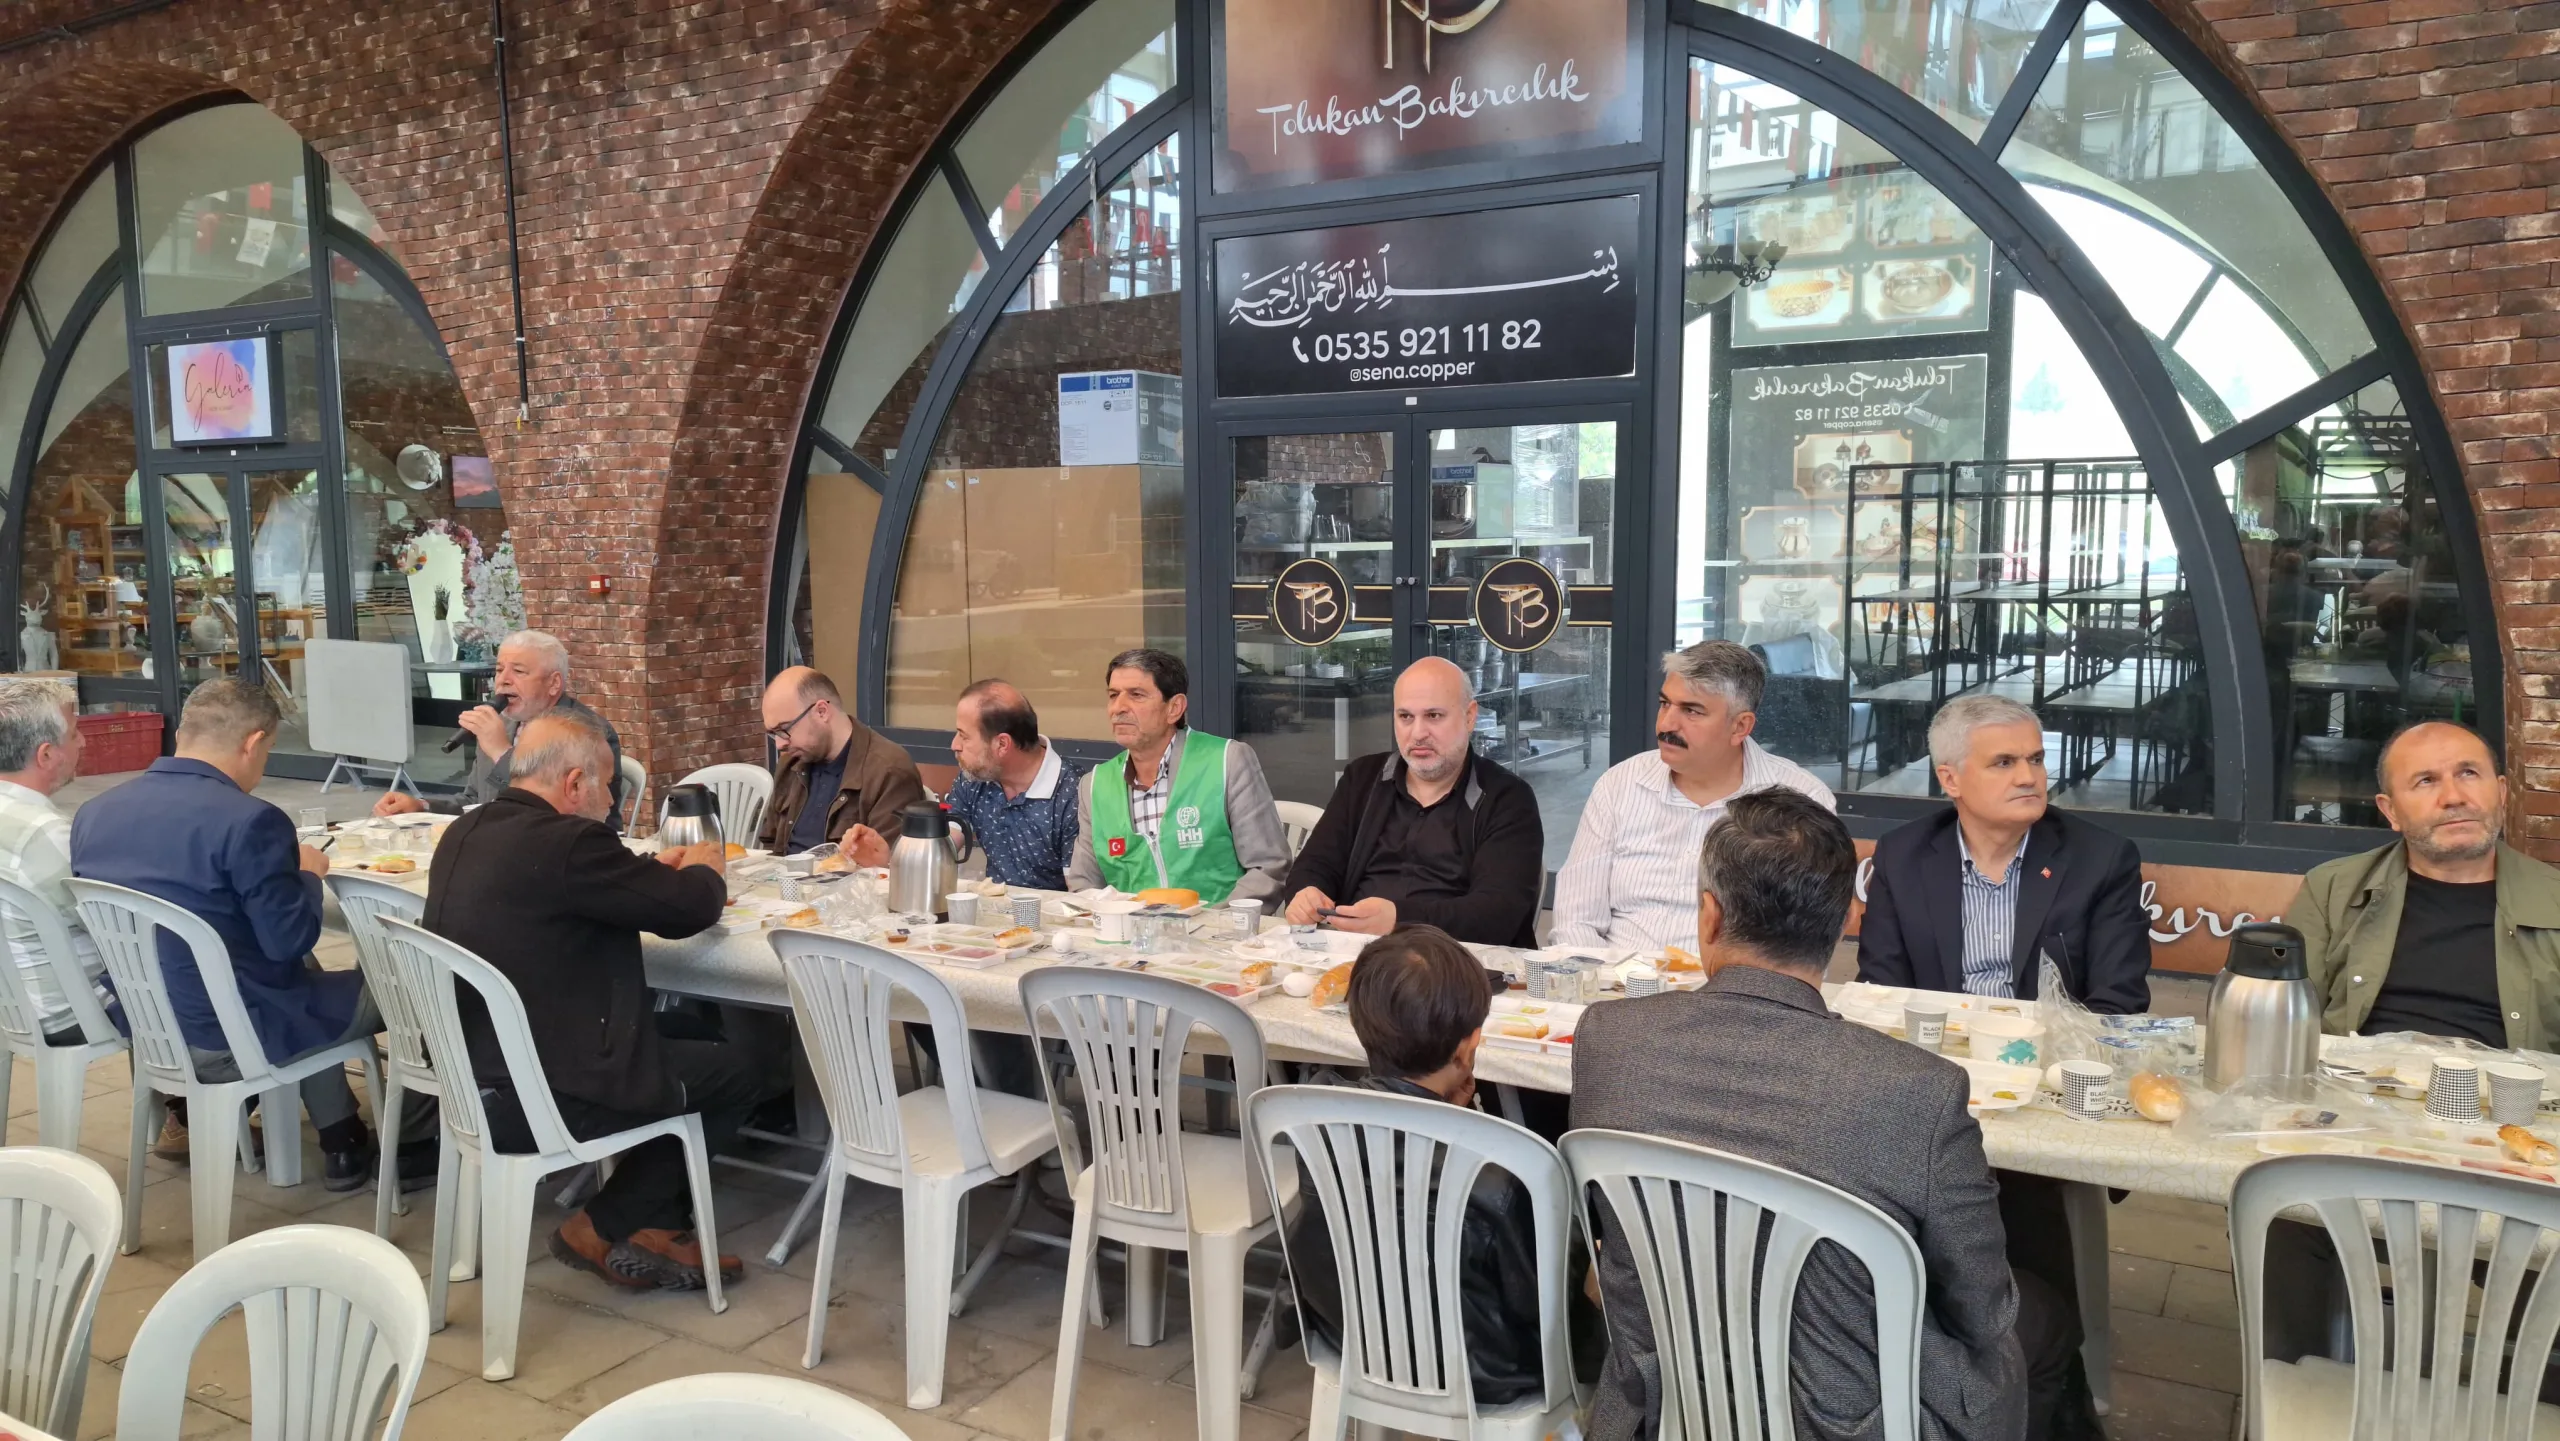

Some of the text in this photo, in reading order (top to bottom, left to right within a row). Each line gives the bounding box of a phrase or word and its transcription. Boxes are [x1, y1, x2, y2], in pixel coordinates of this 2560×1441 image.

[1256, 58, 1590, 156] Tolukan Bakırcılık
[1315, 318, 1542, 362] 0535 921 11 82
[1106, 376, 1131, 385] brother
